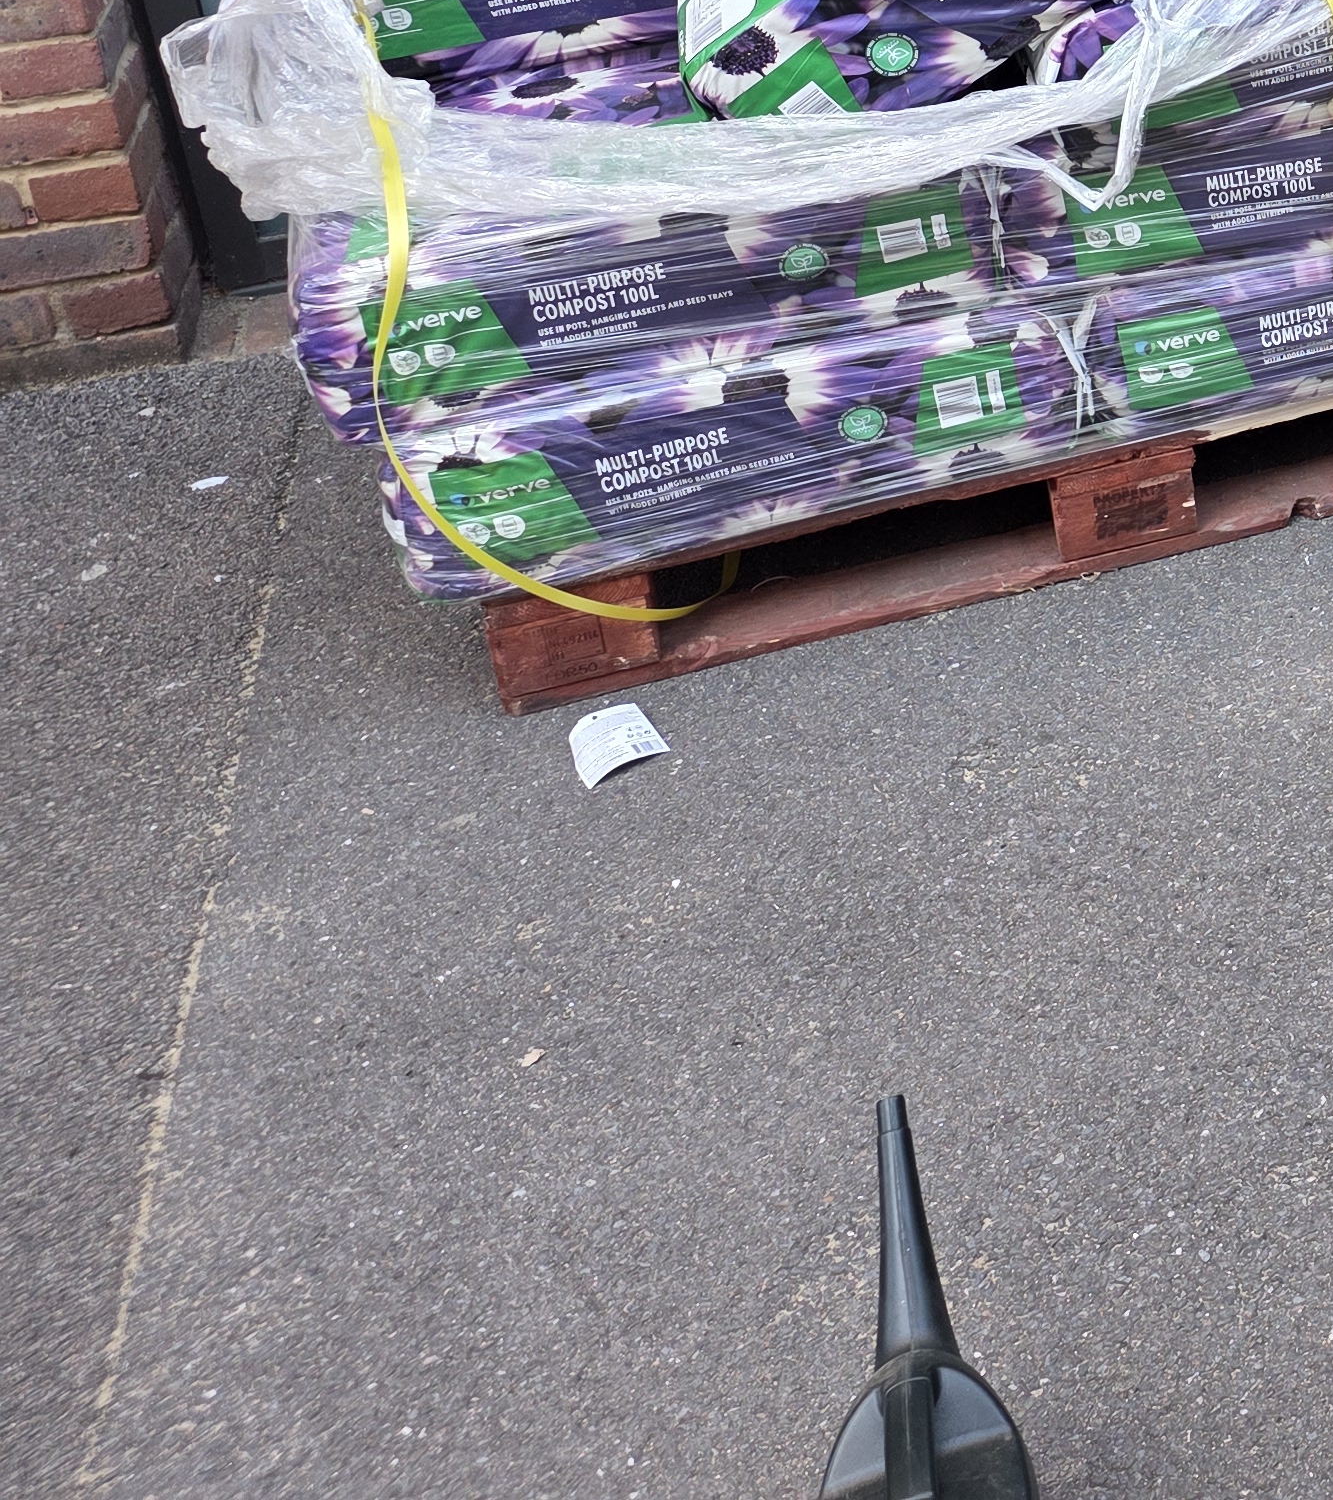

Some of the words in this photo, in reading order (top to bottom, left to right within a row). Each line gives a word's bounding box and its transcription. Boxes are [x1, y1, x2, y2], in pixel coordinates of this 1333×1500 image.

[490, 8, 511, 18] WITH
[512, 2, 538, 15] ADDED
[1206, 157, 1323, 192] MULTI-PURPOSE
[1208, 182, 1280, 208] COMPOST
[1282, 175, 1316, 195] 100L
[528, 262, 666, 305] MULTI-PURPOSE
[407, 305, 482, 332] verve
[532, 292, 616, 323] COMPOST
[619, 284, 660, 307] 100L
[538, 326, 554, 337] USE
[555, 324, 565, 333] IN
[592, 311, 629, 326] HANGING
[630, 304, 667, 319] BASKETS
[667, 300, 685, 311] AND
[686, 295, 708, 306] SEED
[708, 289, 734, 302] TRAYS
[563, 331, 591, 344] ADDED
[593, 320, 638, 338] NUTRIENTS
[1155, 329, 1221, 352] verve
[1261, 320, 1328, 348] COMPOST
[595, 427, 730, 476] MULTI-PURPOSE
[601, 462, 682, 493] COMPOST
[683, 447, 723, 472] 100L
[657, 477, 694, 494] HANGING
[694, 469, 730, 484] BASKETS
[731, 464, 748, 475] AND
[770, 452, 795, 465] TRAYS
[476, 478, 551, 504] verve
[630, 496, 658, 511] ADDED
